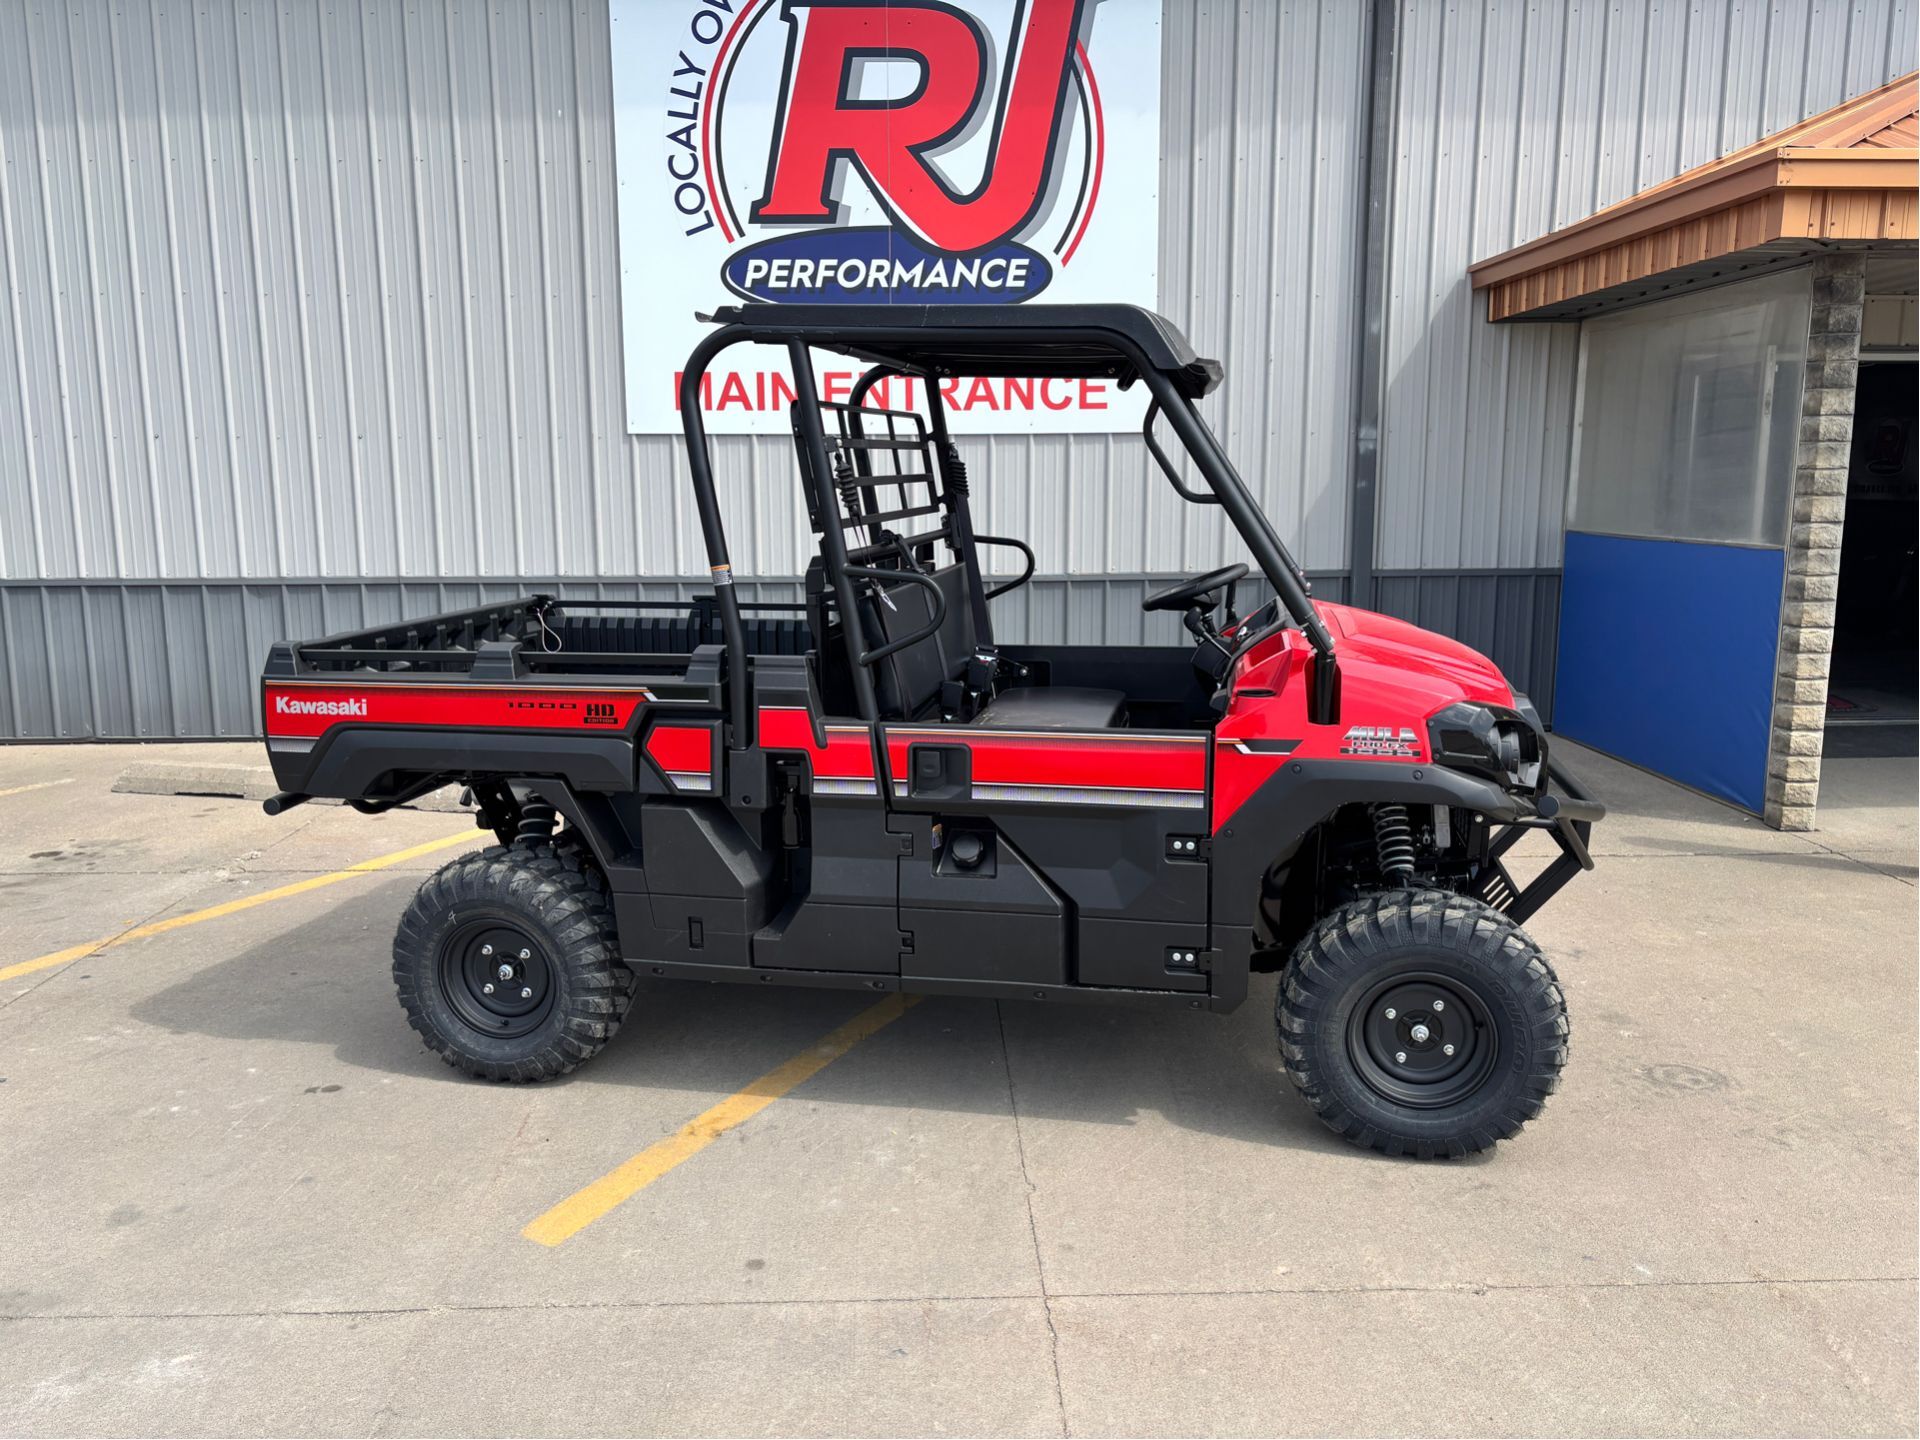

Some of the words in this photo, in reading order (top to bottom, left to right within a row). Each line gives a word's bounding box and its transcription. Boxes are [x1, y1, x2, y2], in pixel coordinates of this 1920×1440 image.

[748, 0, 1094, 254] RJ
[666, 50, 714, 237] LOCALLY
[743, 258, 1029, 289] PERFORMANCE
[275, 695, 368, 716] Kawasaki
[586, 703, 615, 716] HD
